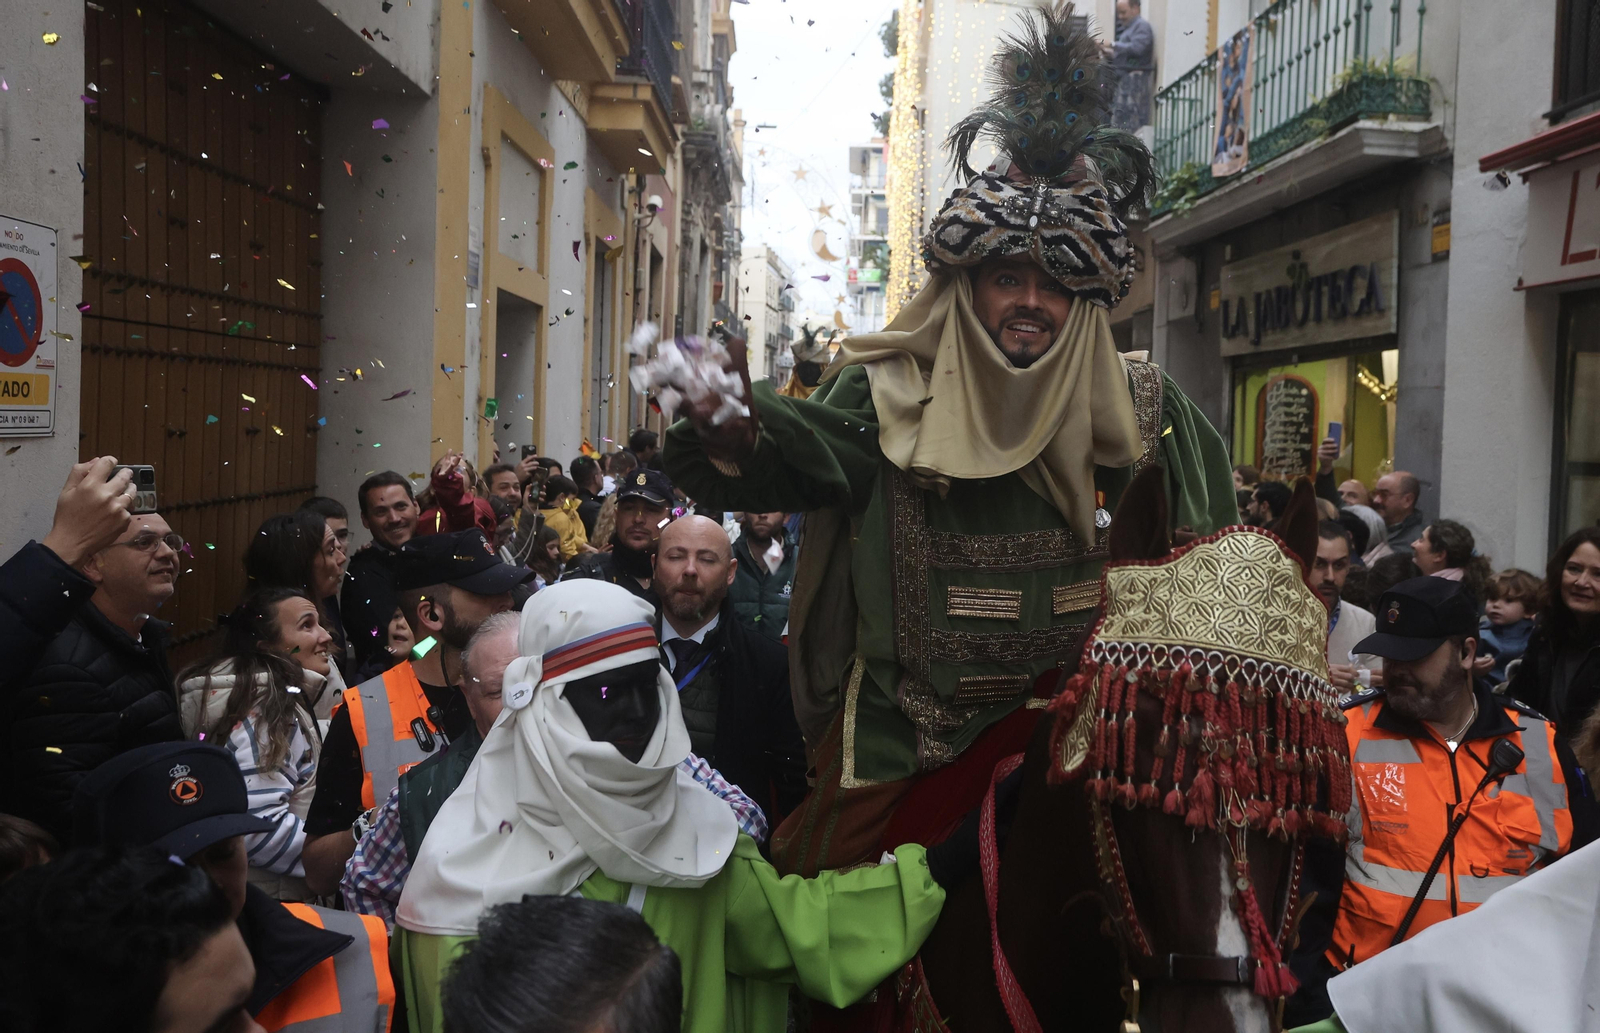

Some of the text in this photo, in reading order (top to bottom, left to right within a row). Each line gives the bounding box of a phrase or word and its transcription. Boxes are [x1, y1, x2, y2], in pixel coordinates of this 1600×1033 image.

[4, 230, 24, 241] NO DO
[1222, 296, 1249, 340] LA
[0, 380, 30, 397] ADO
